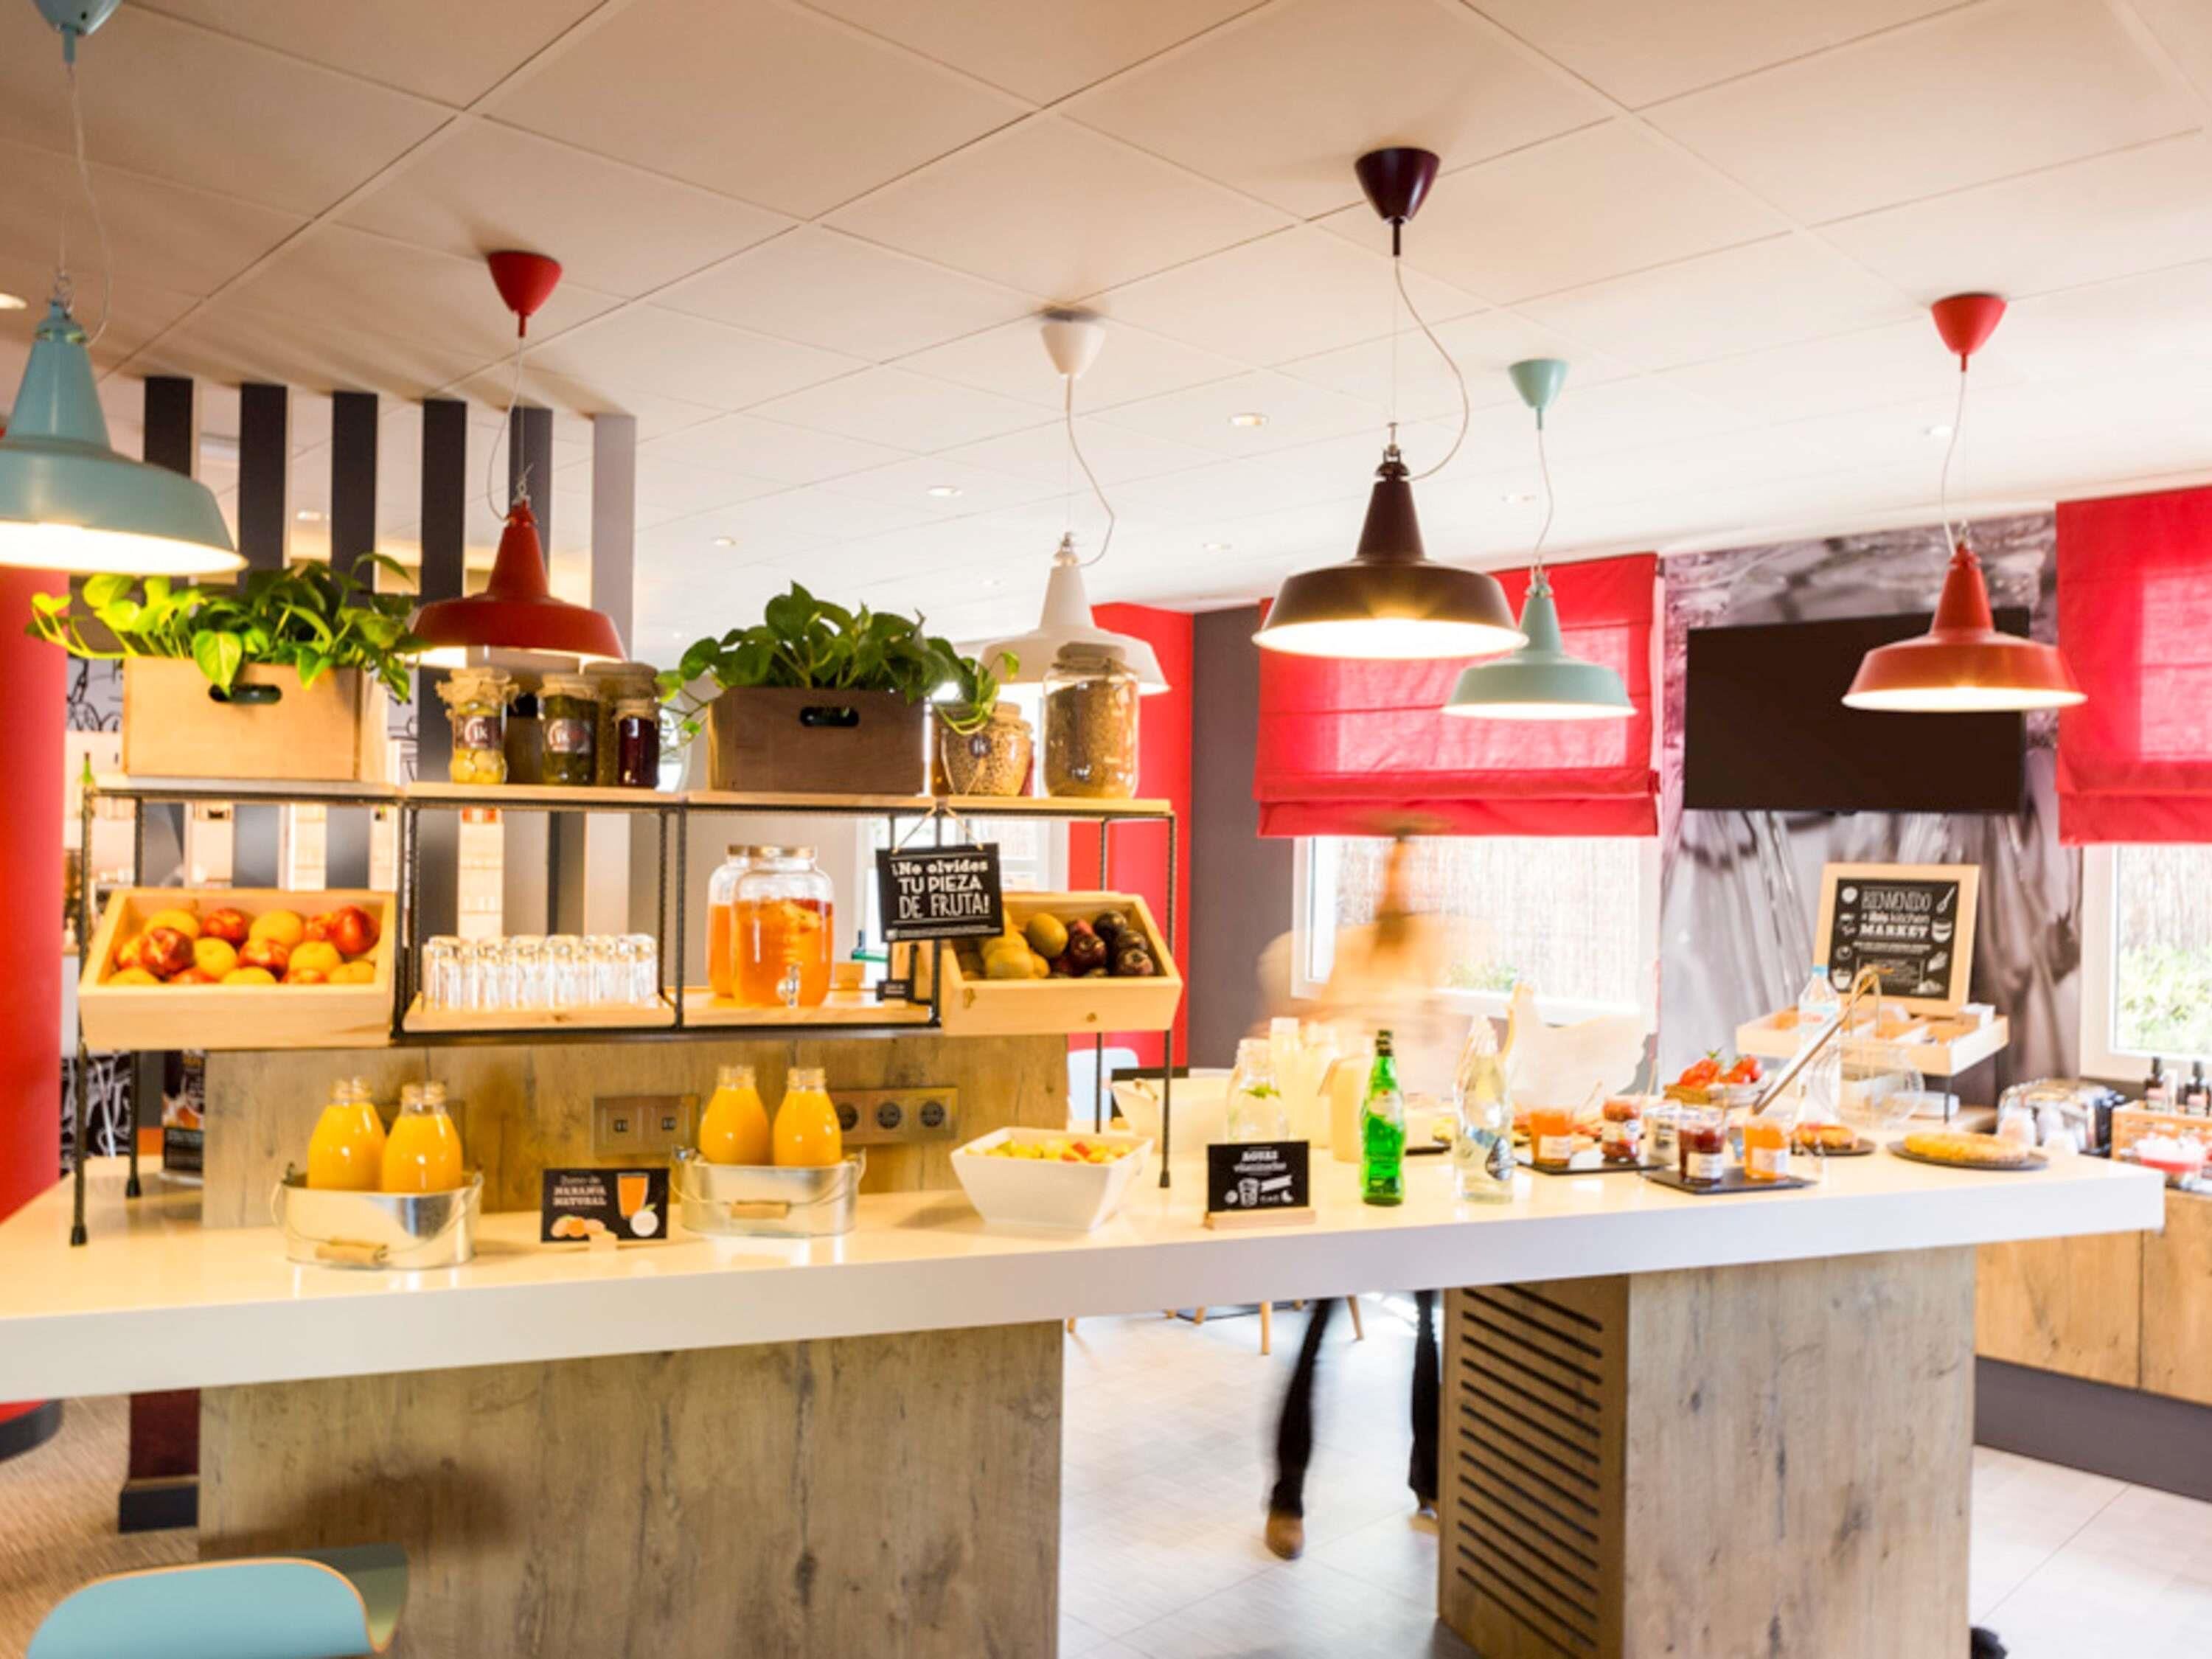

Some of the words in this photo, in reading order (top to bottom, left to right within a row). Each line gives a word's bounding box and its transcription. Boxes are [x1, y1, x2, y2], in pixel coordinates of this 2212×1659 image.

[926, 859, 988, 874] olvides
[897, 876, 925, 894] TU
[927, 874, 983, 893] PIEZA
[899, 896, 923, 919] DE
[930, 894, 991, 917] FRUTA!
[1860, 925, 1930, 937] MARKET
[552, 1196, 607, 1206] NATURAL
